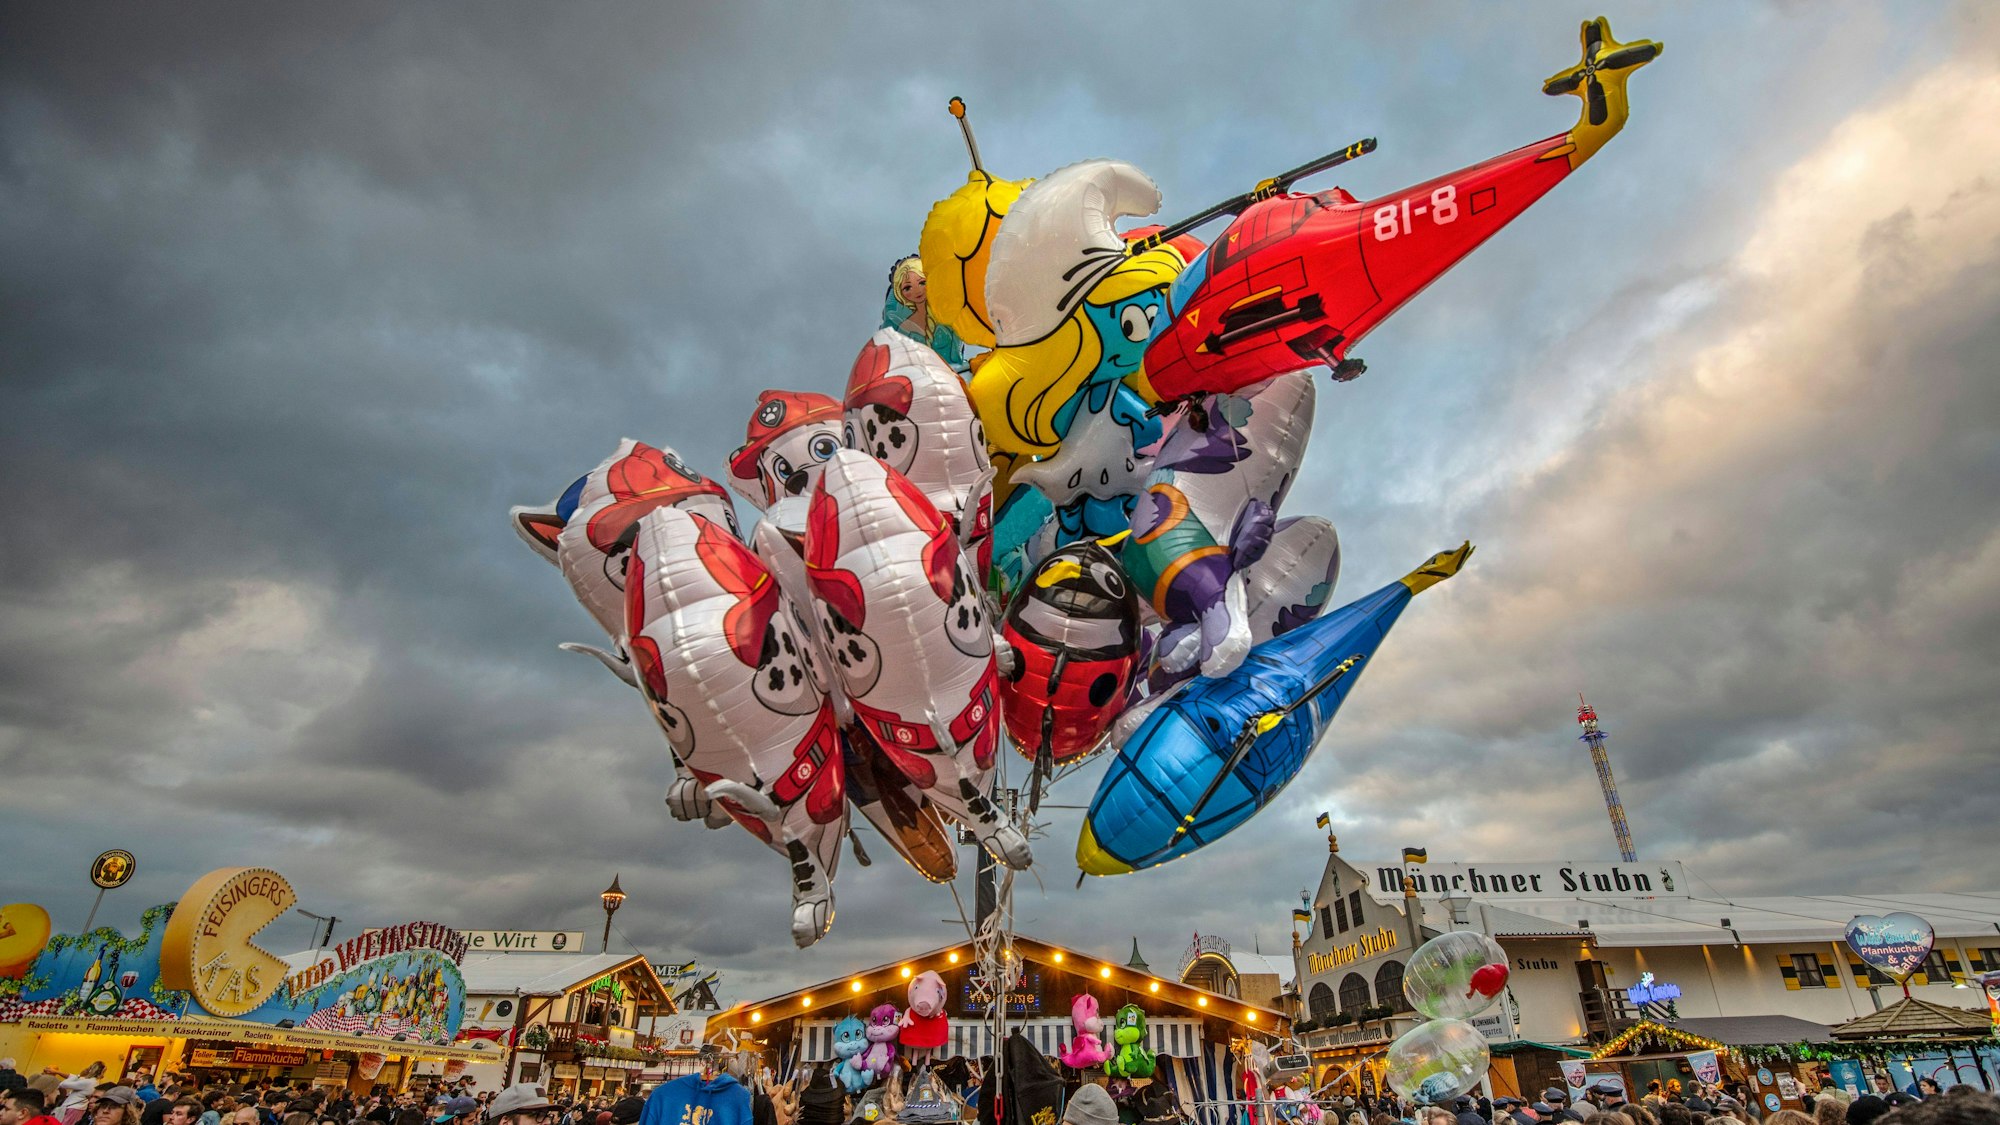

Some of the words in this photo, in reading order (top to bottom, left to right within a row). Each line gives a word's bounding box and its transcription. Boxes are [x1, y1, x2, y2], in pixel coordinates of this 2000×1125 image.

[1373, 184, 1459, 242] 81-8
[1376, 867, 1543, 893] Münchner
[1559, 867, 1653, 892] Stubn
[203, 876, 286, 938] FEISINGERS
[334, 920, 469, 972] WEINSTUBN
[493, 932, 538, 948] Wirt
[1307, 942, 1358, 975] Münchner
[1359, 926, 1397, 958] Stubn
[1861, 944, 1925, 956] Pfannkuchen
[1517, 958, 1559, 970] Stubn
[1887, 955, 1899, 964] &
[27, 1020, 69, 1031] Raclette
[86, 1022, 155, 1033] Flammkuchen
[172, 1025, 232, 1037] Käsekrainer
[243, 1030, 274, 1041] Raclette
[285, 1034, 324, 1046] Käsespatzen
[387, 1044, 416, 1055] Käsekrainer
[234, 1050, 305, 1065] Flammkuchen
